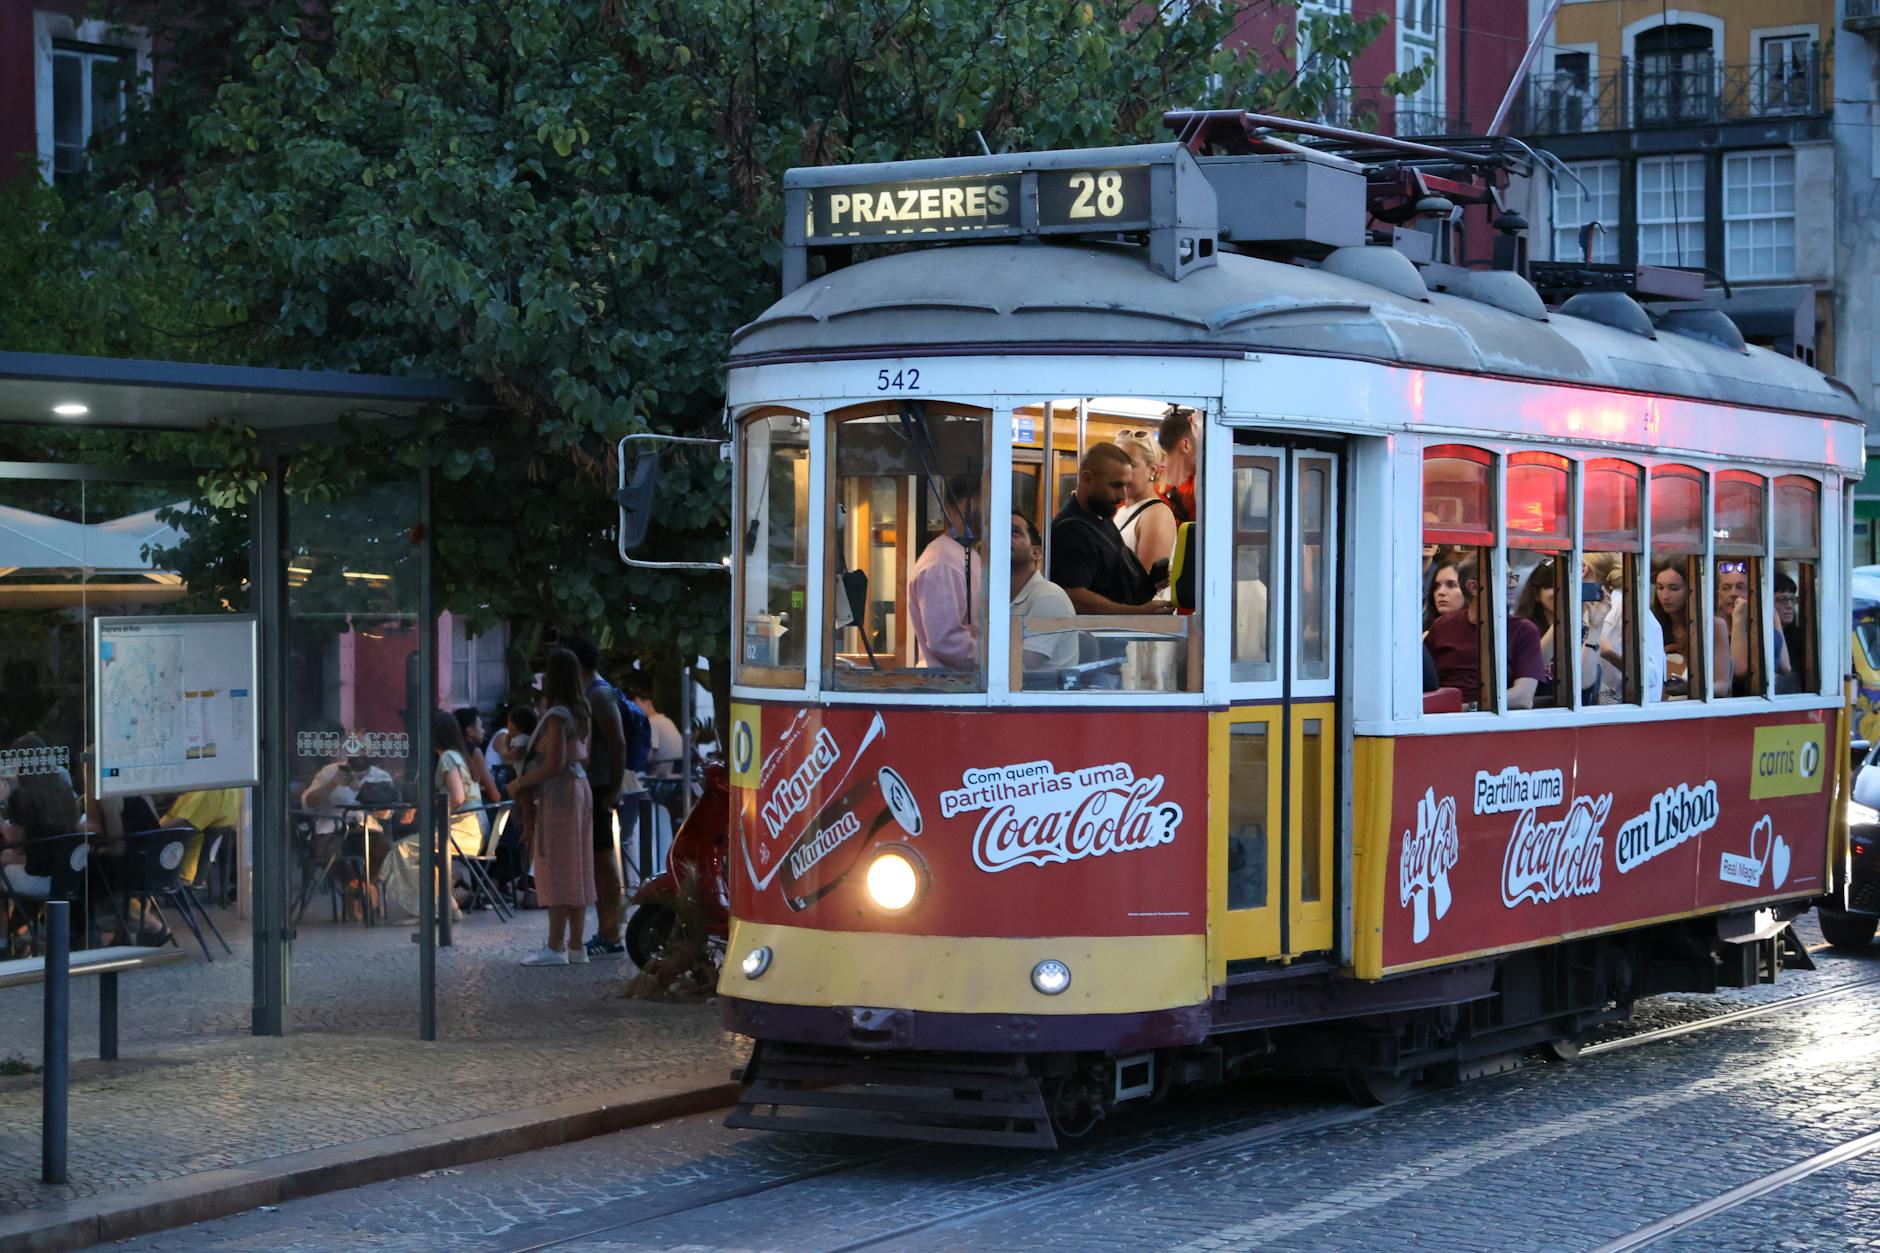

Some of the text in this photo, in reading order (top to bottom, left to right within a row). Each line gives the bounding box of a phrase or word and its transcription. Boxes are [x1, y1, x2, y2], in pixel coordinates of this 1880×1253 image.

[830, 170, 1124, 224] PRAZERES 28
[877, 368, 920, 391] 542
[967, 764, 1049, 785] Com quem
[1759, 739, 1795, 777] carris
[762, 730, 839, 837] Miguel
[944, 767, 1129, 812] partilharias uma
[1477, 775, 1561, 807] Partilha uma
[791, 812, 860, 879] Mariana
[1618, 788, 1716, 865] em Lisboa
[1504, 798, 1610, 904] Coca-Cola
[1723, 859, 1737, 876] Real
